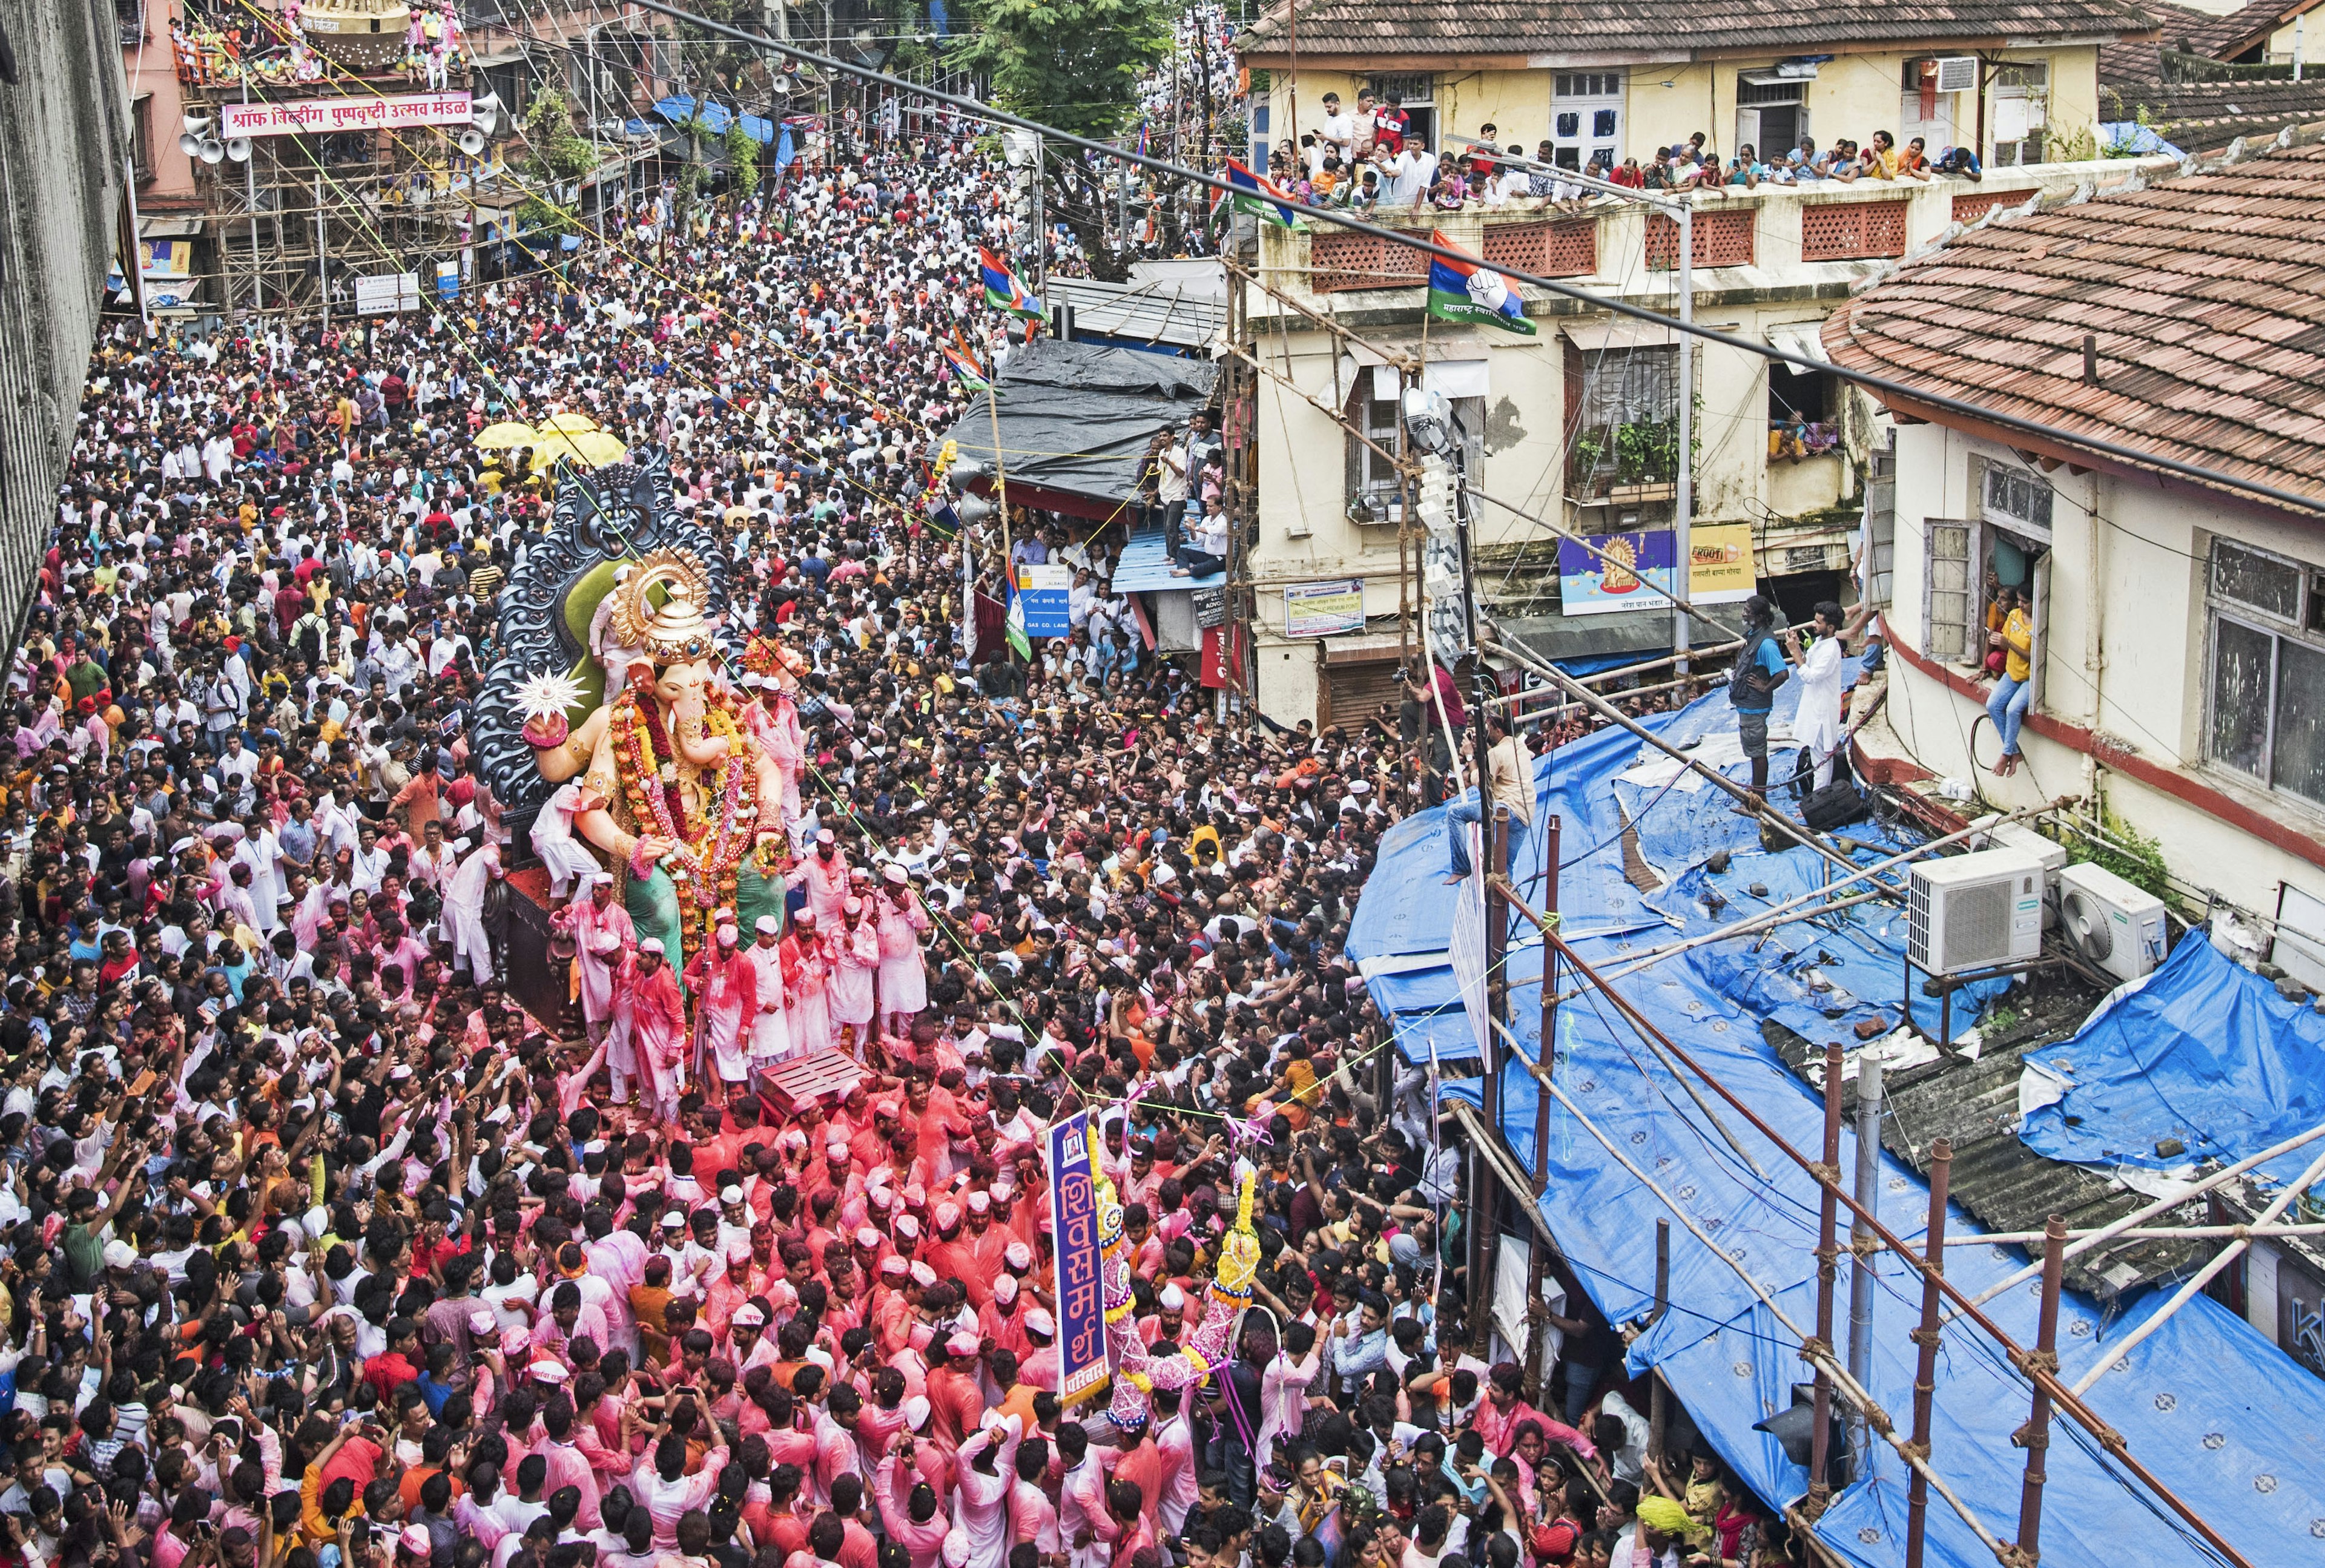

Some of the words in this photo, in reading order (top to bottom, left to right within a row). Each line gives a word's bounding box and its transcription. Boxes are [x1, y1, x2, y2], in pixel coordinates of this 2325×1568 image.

[232, 109, 267, 128] श्रॉफ
[271, 104, 324, 125] बिल्डींग
[331, 100, 386, 127] पुष्पवृष्टी
[390, 102, 428, 118] उत्सव
[432, 96, 467, 115] मंडळ
[1244, 202, 1264, 217] महाराष्ट्र
[1265, 210, 1283, 220] स्वाभि
[1443, 303, 1474, 314] महाराष्ट्र
[1059, 1171, 1096, 1364] शिवसमर्थ
[1066, 1360, 1105, 1393] परिवार
